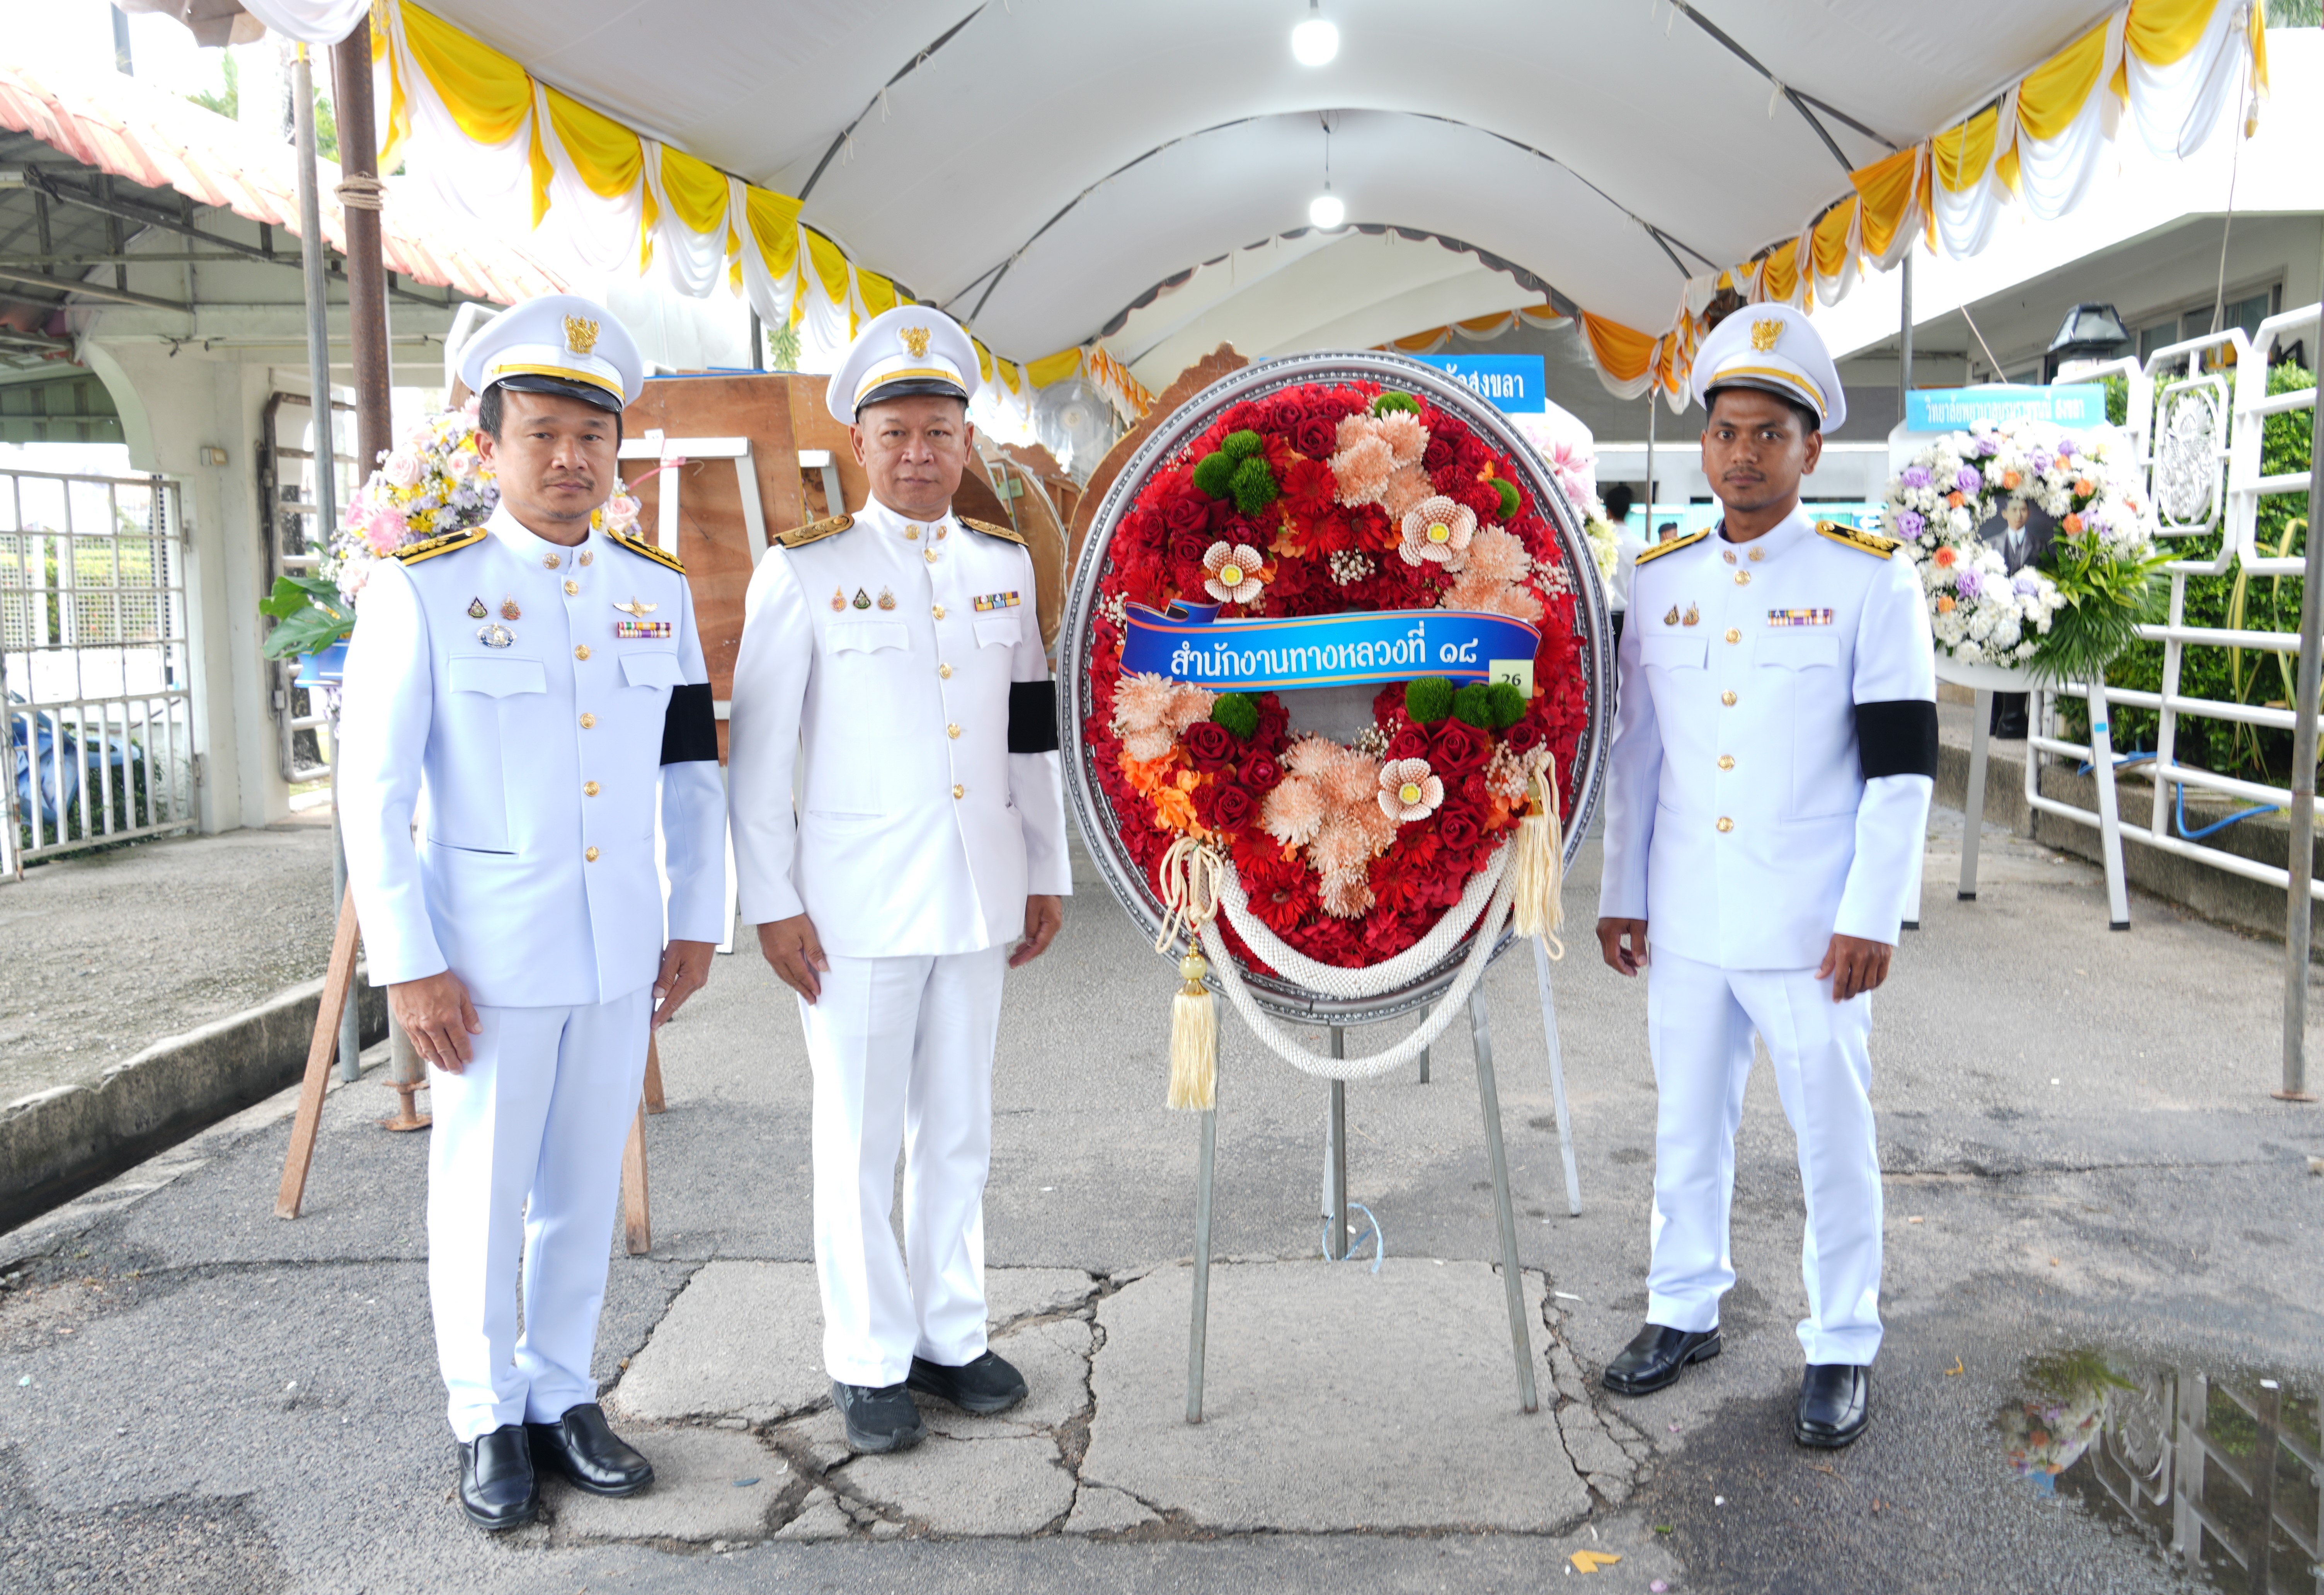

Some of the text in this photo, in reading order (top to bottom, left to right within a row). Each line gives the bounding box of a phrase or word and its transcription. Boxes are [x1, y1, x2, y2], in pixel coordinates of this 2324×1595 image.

[1171, 620, 1479, 677] สำนักงานทางหลวงที่ ๑๘
[1501, 673, 1521, 686] 26
